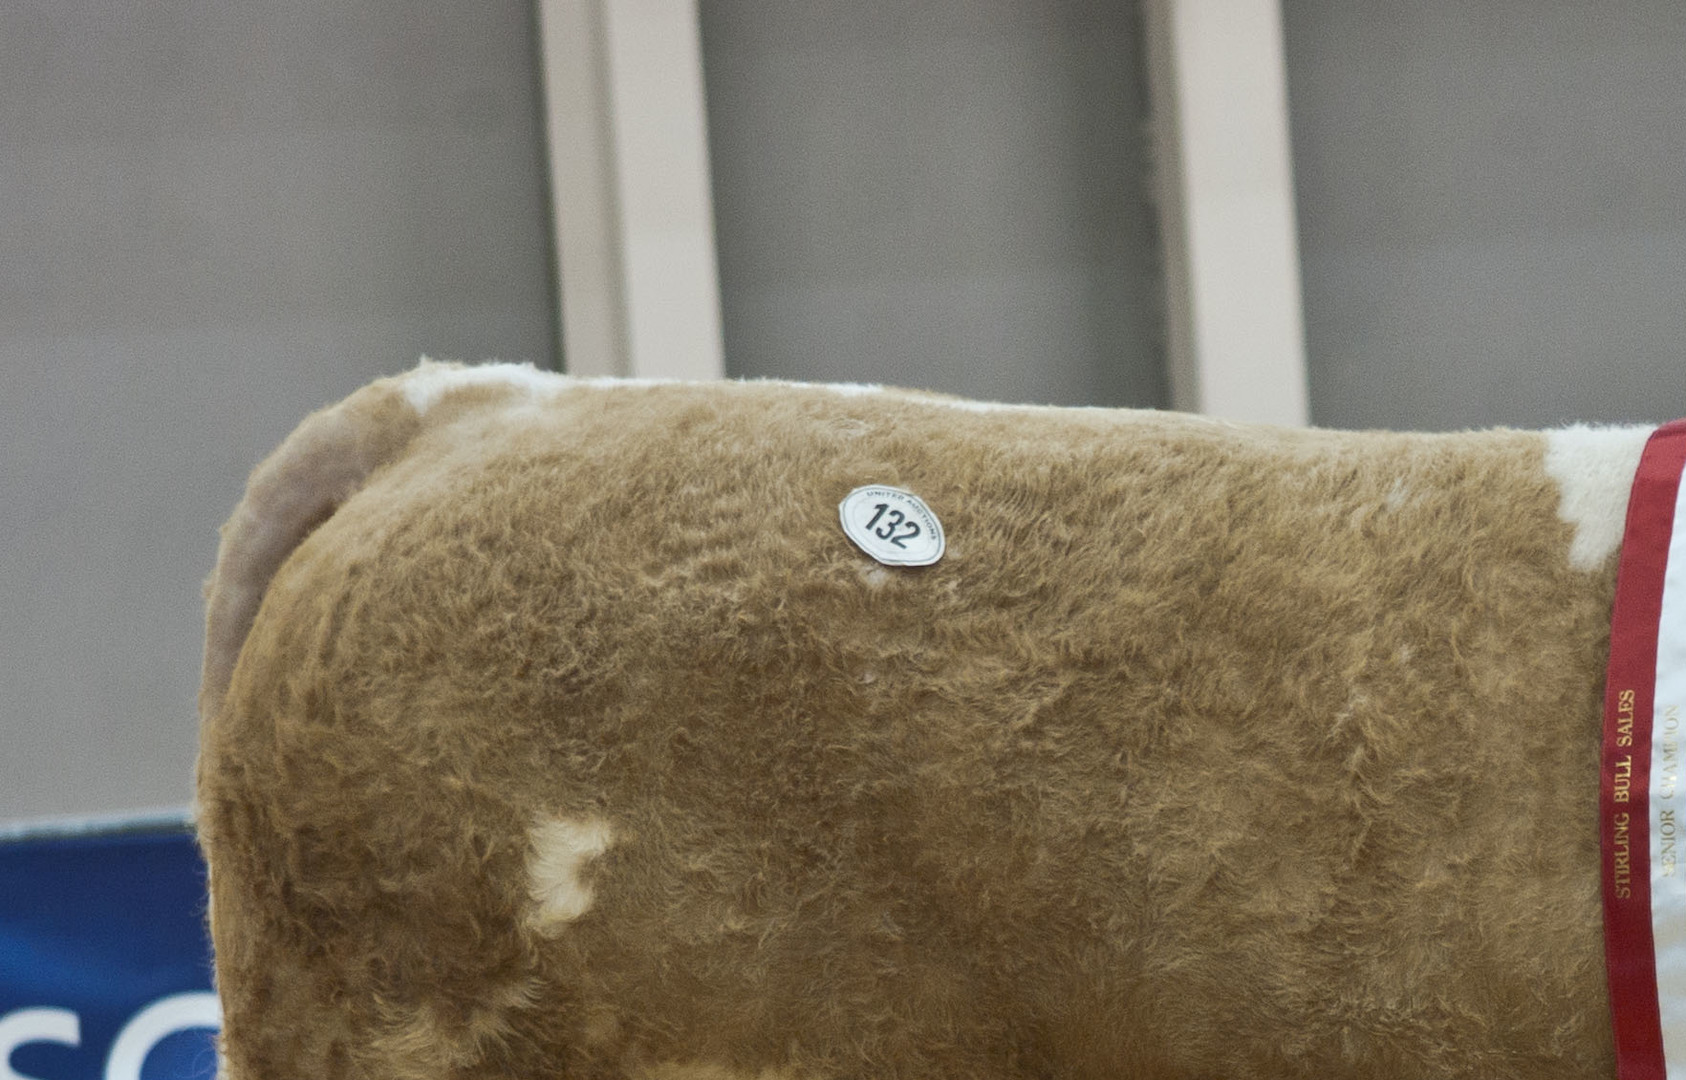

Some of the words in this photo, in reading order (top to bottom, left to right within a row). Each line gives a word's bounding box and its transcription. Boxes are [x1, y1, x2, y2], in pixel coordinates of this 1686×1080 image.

[865, 503, 921, 550] 132
[866, 491, 904, 500] UNITED
[906, 500, 936, 540] AUCTIONS
[1618, 690, 1635, 747] SALES
[1614, 755, 1632, 803] BULL
[1660, 704, 1680, 800] CHAMPION
[1614, 812, 1632, 900] STIRLING
[1660, 810, 1676, 878] SENIOR
